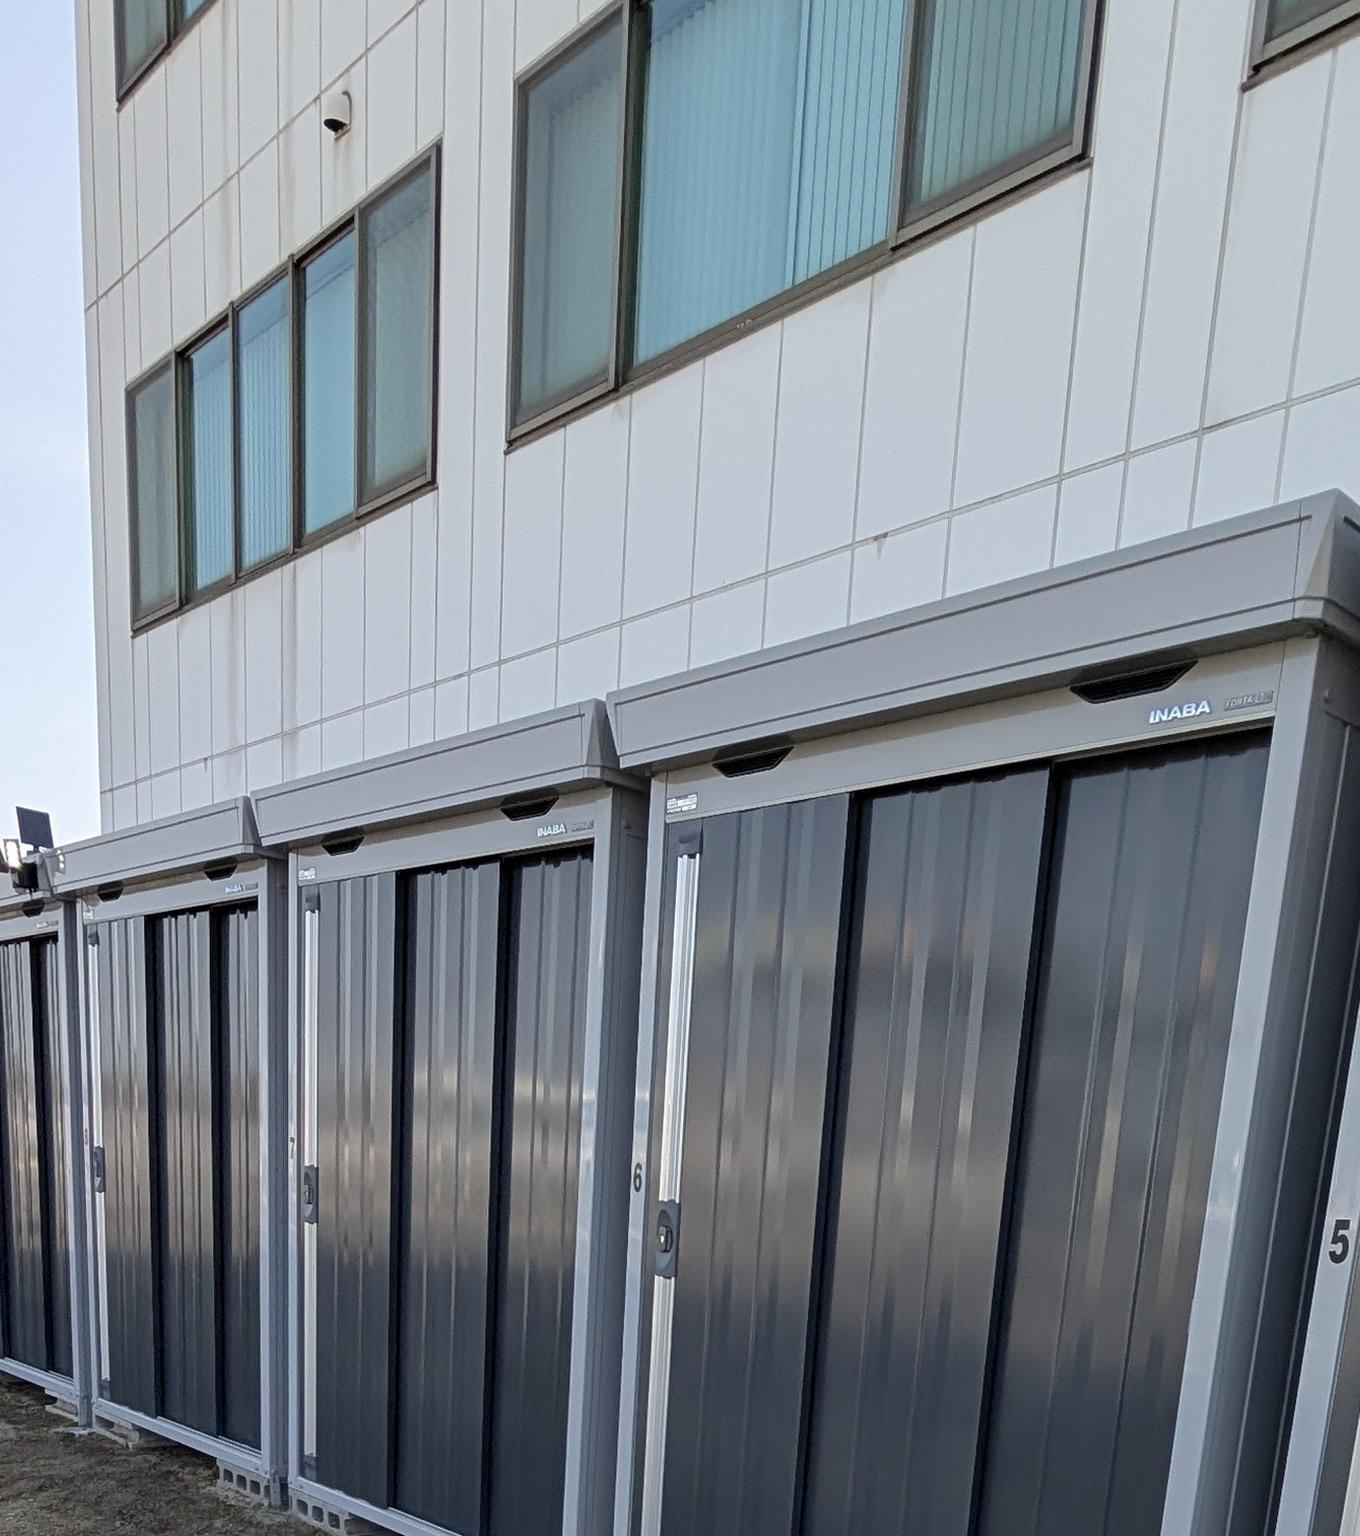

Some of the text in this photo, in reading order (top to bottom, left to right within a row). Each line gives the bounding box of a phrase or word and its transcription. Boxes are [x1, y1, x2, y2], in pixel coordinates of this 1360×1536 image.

[1149, 700, 1211, 724] INABA
[289, 1136, 296, 1159] 7
[633, 1162, 642, 1192] 6
[1328, 1219, 1351, 1264] 5
